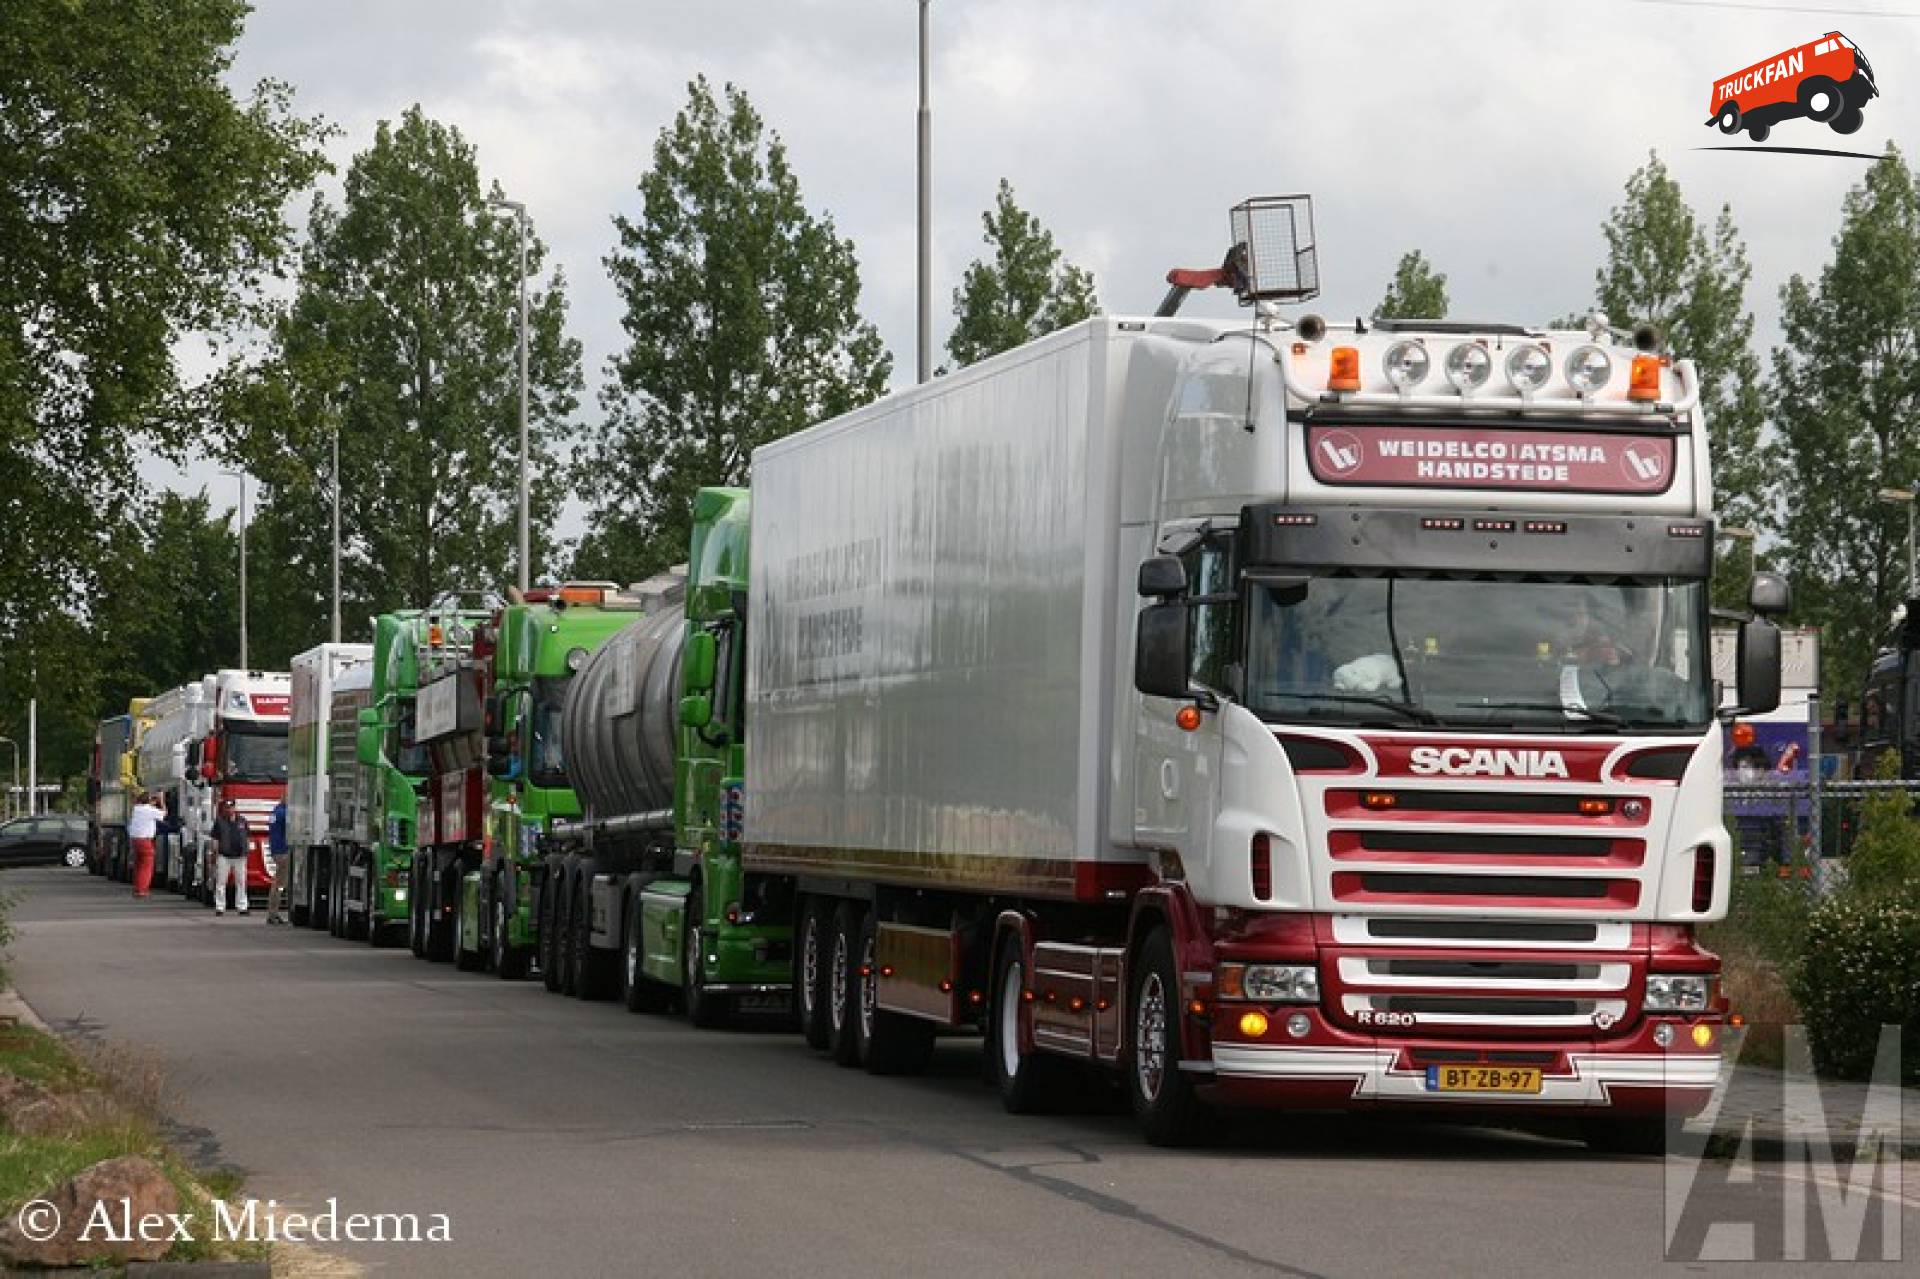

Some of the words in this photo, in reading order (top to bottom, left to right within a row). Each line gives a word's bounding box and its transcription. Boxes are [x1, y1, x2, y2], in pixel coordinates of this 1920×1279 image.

[1417, 460, 1569, 482] HANDSTEDE
[1409, 746, 1570, 778] SCANIA
[1357, 1011, 1372, 1024] R
[1374, 1011, 1415, 1026] 620
[1446, 1069, 1532, 1089] BT-ZB-97
